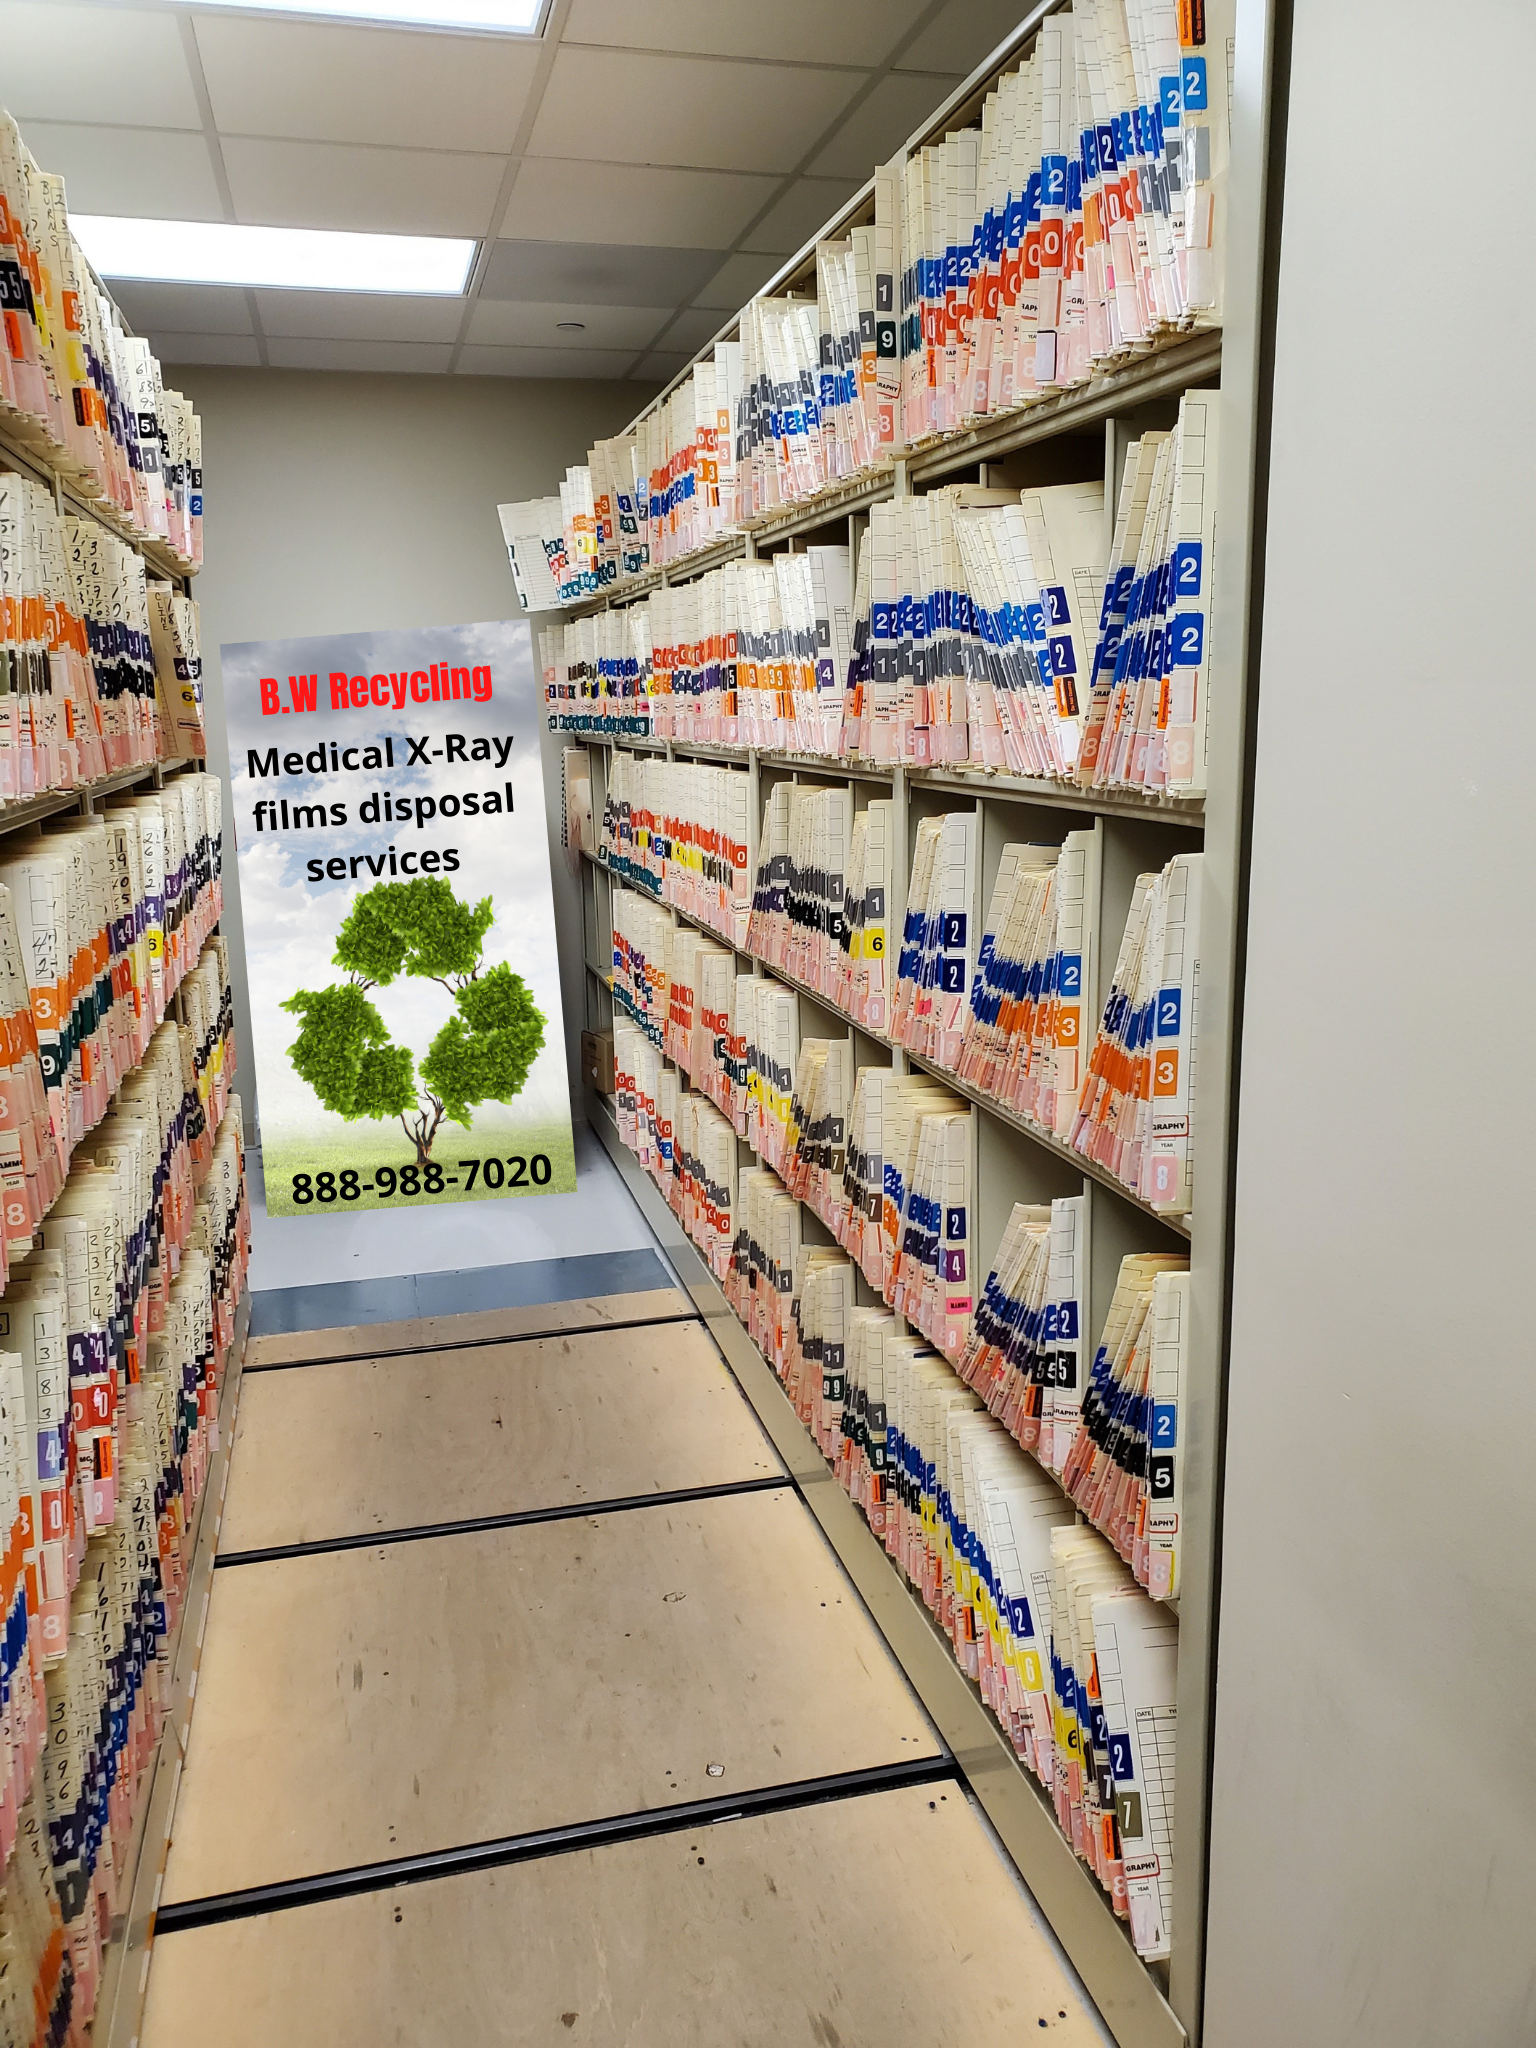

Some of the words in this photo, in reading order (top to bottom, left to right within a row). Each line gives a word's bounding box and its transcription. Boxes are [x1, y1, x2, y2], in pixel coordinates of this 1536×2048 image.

[1187, 72, 1200, 95] 2
[1167, 90, 1180, 113] 2
[1102, 135, 1113, 162] 2
[1048, 170, 1063, 192] 2
[41, 181, 58, 247] BURNS
[1110, 193, 1120, 220] 0
[1044, 231, 1059, 254] 0
[960, 258, 971, 277] 2
[12, 271, 21, 299] 5
[879, 285, 888, 301] 1
[862, 321, 870, 334] 1
[882, 330, 893, 348] 9
[826, 343, 833, 356] 1
[865, 360, 876, 375] 3
[809, 408, 815, 418] 2
[720, 416, 726, 427] 0
[789, 420, 796, 429] 2
[880, 412, 891, 432] 8
[699, 433, 704, 444] 0
[722, 448, 727, 459] 3
[710, 464, 715, 479] 3
[639, 483, 645, 492] 2
[602, 500, 608, 509] 3
[623, 499, 629, 509] 2
[641, 508, 646, 516] 7
[605, 525, 609, 533] 0
[609, 567, 614, 575] 9
[1180, 557, 1197, 582] 2
[155, 592, 168, 631] CLINE
[1051, 594, 1060, 618] 2
[876, 613, 887, 629] 2
[819, 627, 826, 640] 1
[1181, 628, 1199, 651] 2
[730, 638, 735, 653] 0
[774, 638, 778, 654] 1
[978, 653, 984, 675] 1
[1056, 644, 1066, 668] 2
[822, 667, 832, 679] 4
[878, 658, 886, 673] 1
[916, 660, 924, 676] 1
[730, 667, 734, 684] 5
[750, 668, 756, 683] 3
[769, 667, 775, 684] 3
[777, 670, 782, 686] 3
[259, 673, 318, 716] B.W
[328, 661, 494, 711] Recycling
[246, 736, 395, 778] Medical
[406, 733, 515, 770] X-Ray
[252, 797, 348, 832] films
[359, 782, 516, 830] disposal
[656, 843, 662, 851] 2
[118, 853, 127, 868] 9
[306, 841, 461, 882] services
[737, 851, 745, 862] 0
[779, 862, 785, 873] 1
[121, 877, 129, 888] 0
[833, 882, 840, 894] 1
[123, 893, 130, 904] 5
[778, 895, 784, 907] 4
[872, 897, 879, 911] 1
[146, 903, 155, 917] 4
[125, 920, 132, 938] 4
[834, 920, 842, 933] 5
[952, 921, 958, 941] 2
[873, 938, 883, 951] 6
[659, 977, 664, 985] 3
[951, 966, 957, 987] 2
[1064, 967, 1078, 985] 2
[35, 998, 51, 1019] 3
[1162, 1003, 1177, 1024] 2
[720, 1018, 726, 1028] 0
[1062, 1018, 1075, 1036] 3
[741, 1043, 746, 1052] 0
[41, 1055, 55, 1075] 9
[1158, 1062, 1174, 1084] 3
[740, 1069, 745, 1082] 9
[782, 1075, 788, 1085] 1
[664, 1125, 670, 1133] 0
[833, 1124, 840, 1136] 1
[666, 1146, 671, 1154] 2
[833, 1154, 839, 1170] 7
[291, 1153, 553, 1205] 888-988-7020
[722, 1192, 728, 1201] 1
[6, 1203, 26, 1226] 8
[870, 1199, 876, 1216] 7
[722, 1220, 728, 1229] 0
[952, 1215, 959, 1235] 2
[953, 1256, 960, 1275] 4
[783, 1276, 789, 1287] 1
[1061, 1310, 1070, 1332] 2
[40, 1348, 50, 1360] 3
[72, 1343, 84, 1366] 4
[95, 1340, 105, 1365] 4
[825, 1351, 831, 1361] 1
[834, 1351, 840, 1362] 1
[1059, 1358, 1066, 1380] 5
[206, 1371, 215, 1384] 0
[42, 1379, 51, 1394] 8
[834, 1379, 839, 1393] 9
[73, 1402, 83, 1420] 0
[98, 1391, 108, 1418] 0
[40, 1408, 51, 1419] 3
[875, 1411, 882, 1423] 1
[1158, 1416, 1170, 1435] 2
[1023, 1428, 1037, 1441] 8
[876, 1449, 882, 1465] 9
[1155, 1468, 1170, 1488] 5
[50, 1500, 62, 1529] 0
[43, 1615, 61, 1639] 8
[1016, 1607, 1025, 1631] 2
[51, 1702, 66, 1722] 3
[55, 1728, 67, 1745] 0
[1114, 1745, 1124, 1772] 2
[58, 1759, 68, 1779] 9
[59, 1782, 69, 1800] 6
[1103, 1775, 1112, 1799] 7
[1123, 1801, 1131, 1828] 7
[62, 1828, 74, 1849] 4
[1114, 1876, 1126, 1897] 8
